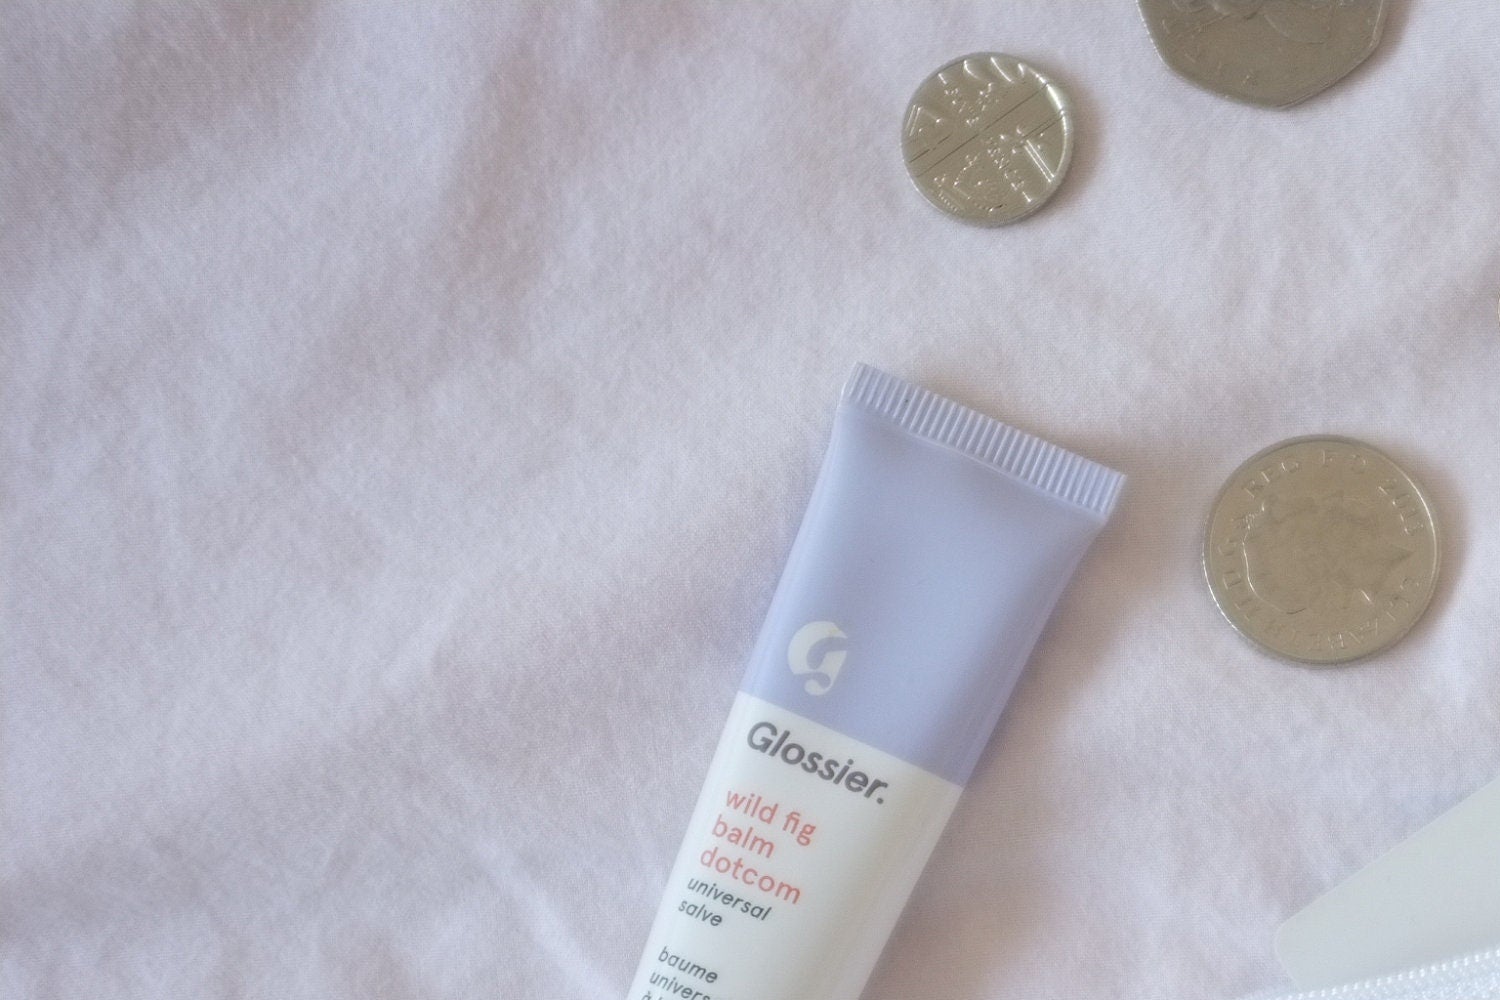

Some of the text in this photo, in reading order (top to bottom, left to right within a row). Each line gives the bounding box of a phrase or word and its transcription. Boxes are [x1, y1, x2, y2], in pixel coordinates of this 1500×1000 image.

[747, 721, 889, 804] Glossier.
[712, 814, 774, 858] balm
[726, 790, 816, 847] wild fig
[700, 846, 801, 905] dotcom
[678, 899, 723, 927] salve
[687, 878, 772, 921] universal
[658, 945, 719, 984] baume
